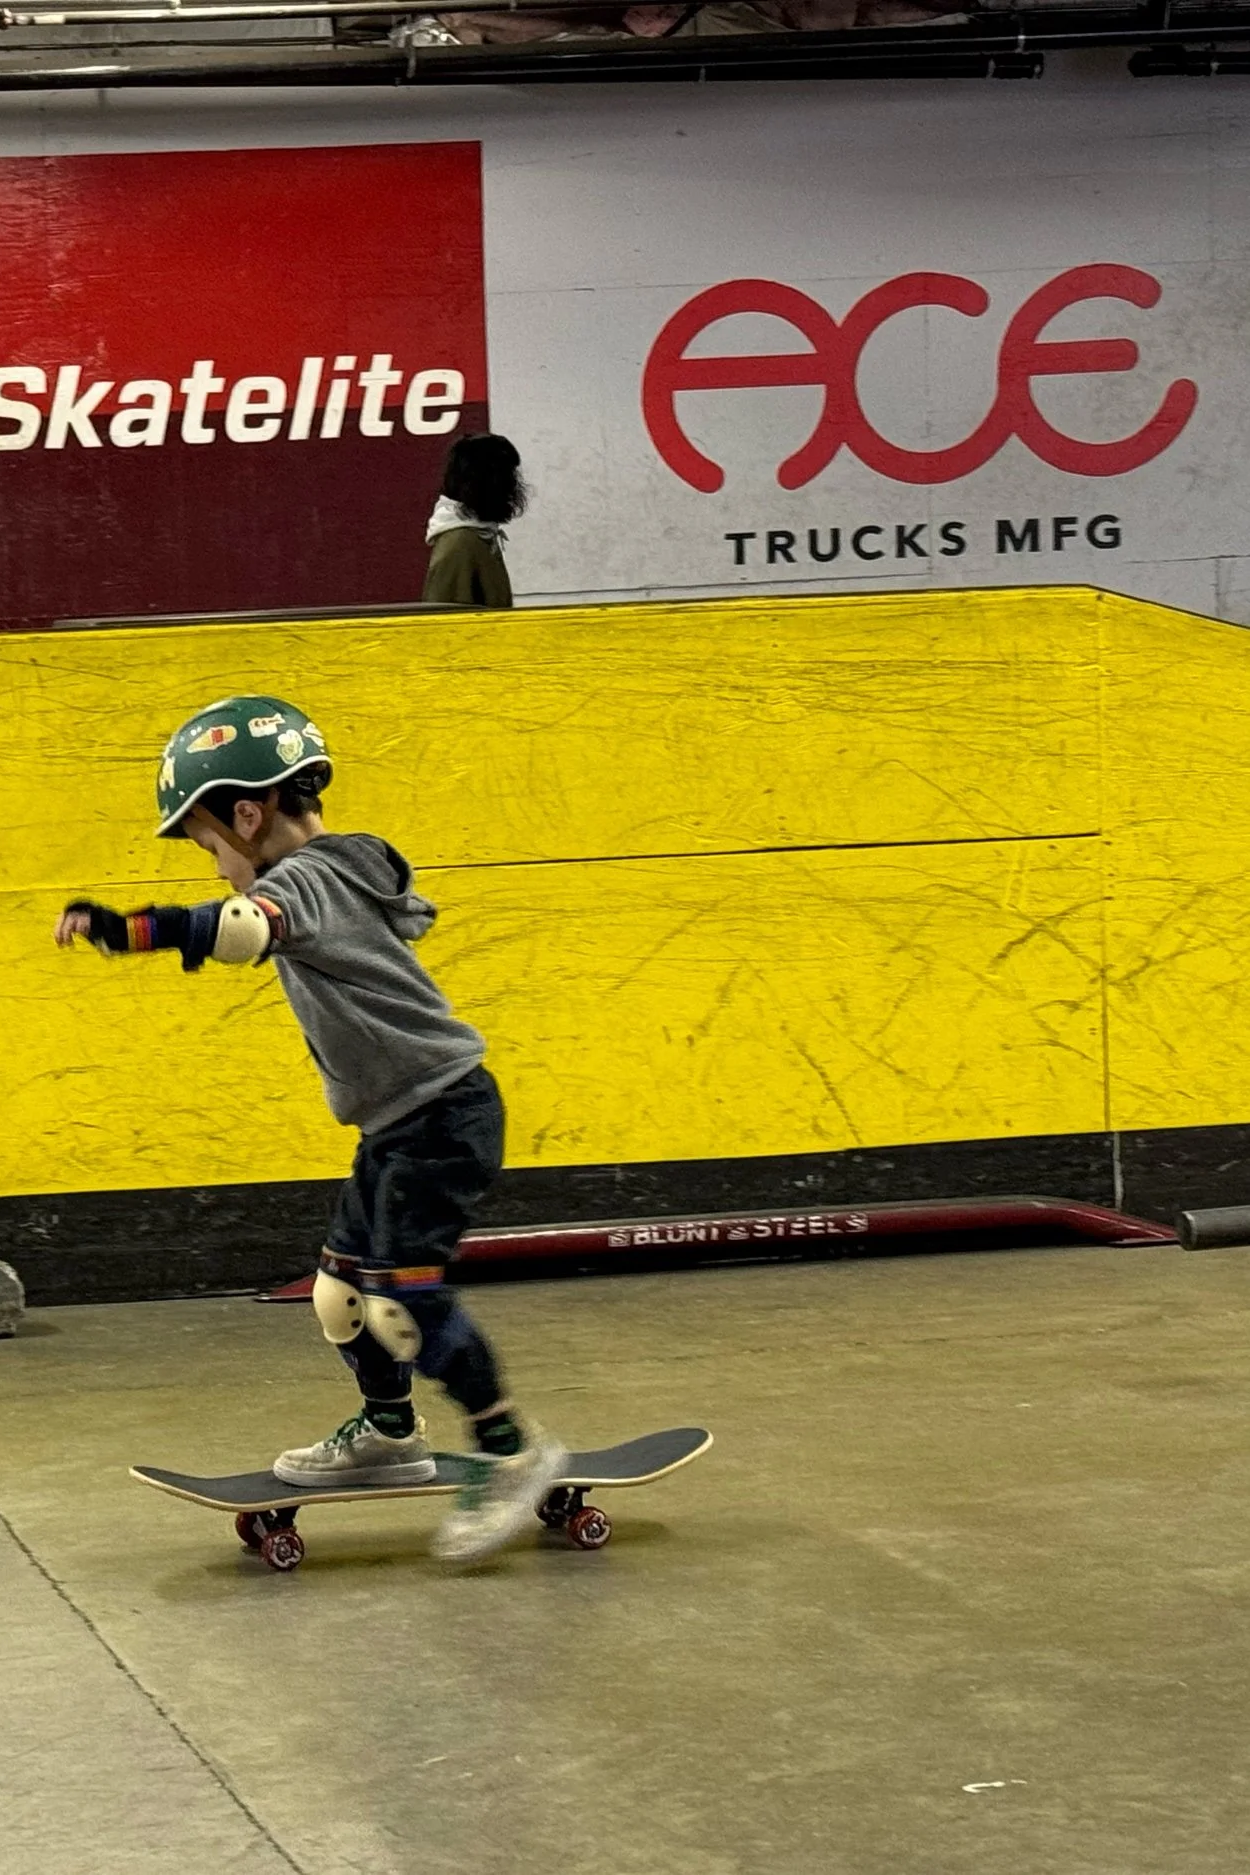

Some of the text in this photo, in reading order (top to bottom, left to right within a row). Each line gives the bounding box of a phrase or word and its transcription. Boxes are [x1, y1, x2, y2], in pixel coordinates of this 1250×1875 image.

[640, 263, 1199, 493] ACE
[724, 514, 1123, 566] TRUCKS MFG
